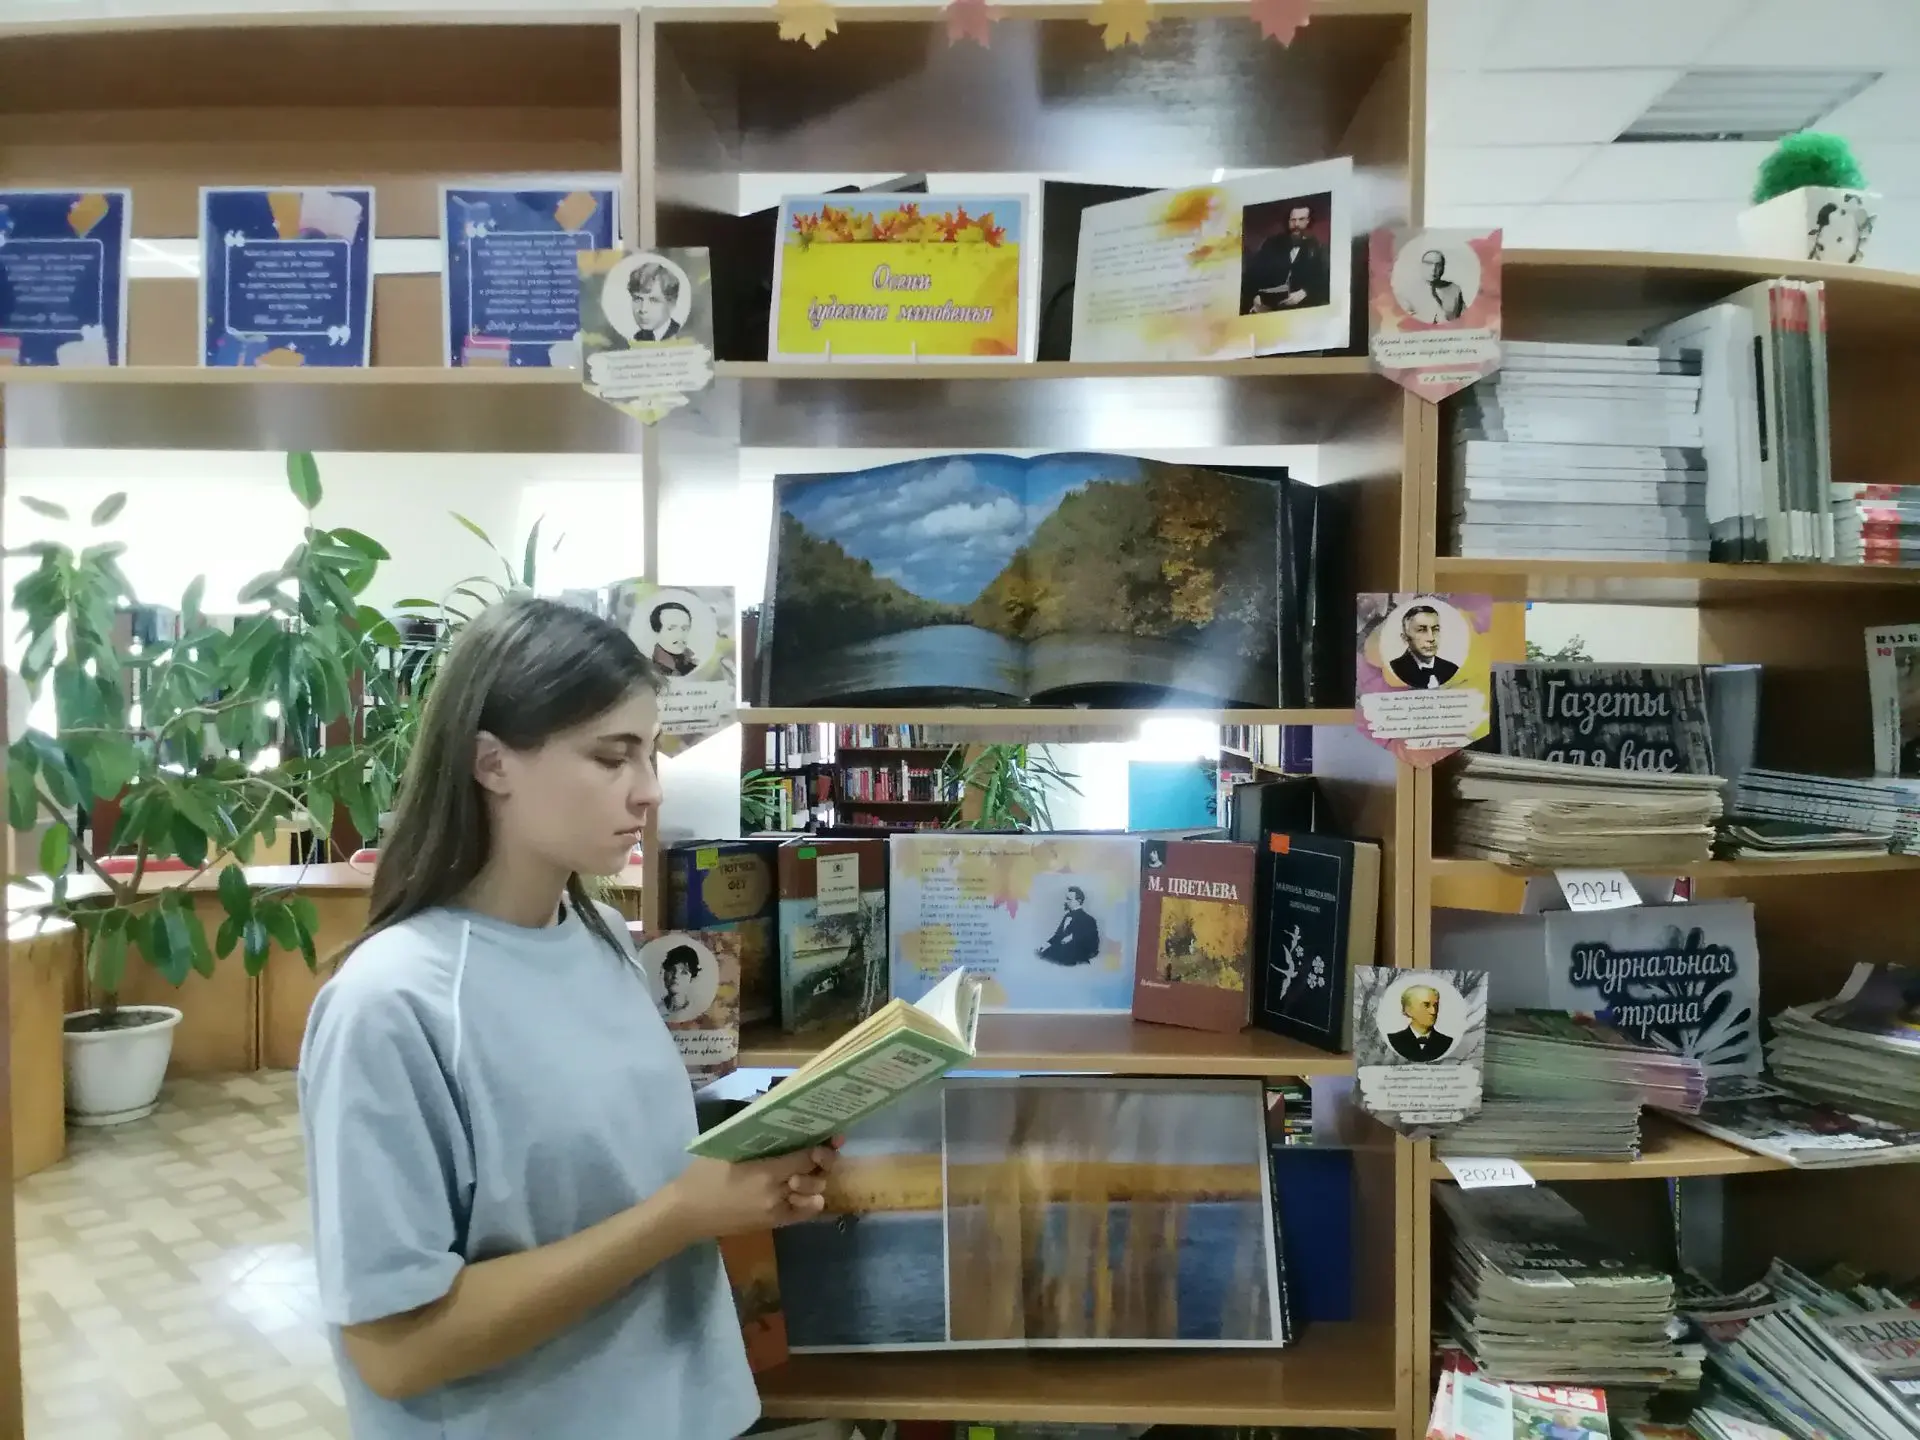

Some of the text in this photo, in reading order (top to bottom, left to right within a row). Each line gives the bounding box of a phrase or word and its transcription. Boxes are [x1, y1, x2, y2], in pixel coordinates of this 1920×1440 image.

[872, 262, 932, 291] Осени
[896, 299, 994, 323] мгновенья
[1546, 679, 1671, 735] Газеты
[1619, 739, 1678, 774] вас
[1147, 876, 1238, 900] М. ЦВЕТАЕВА
[1566, 879, 1624, 906] 2024
[1573, 948, 1733, 994] Журнальная
[1612, 1000, 1702, 1040] страна
[1458, 1166, 1516, 1183] 2024
